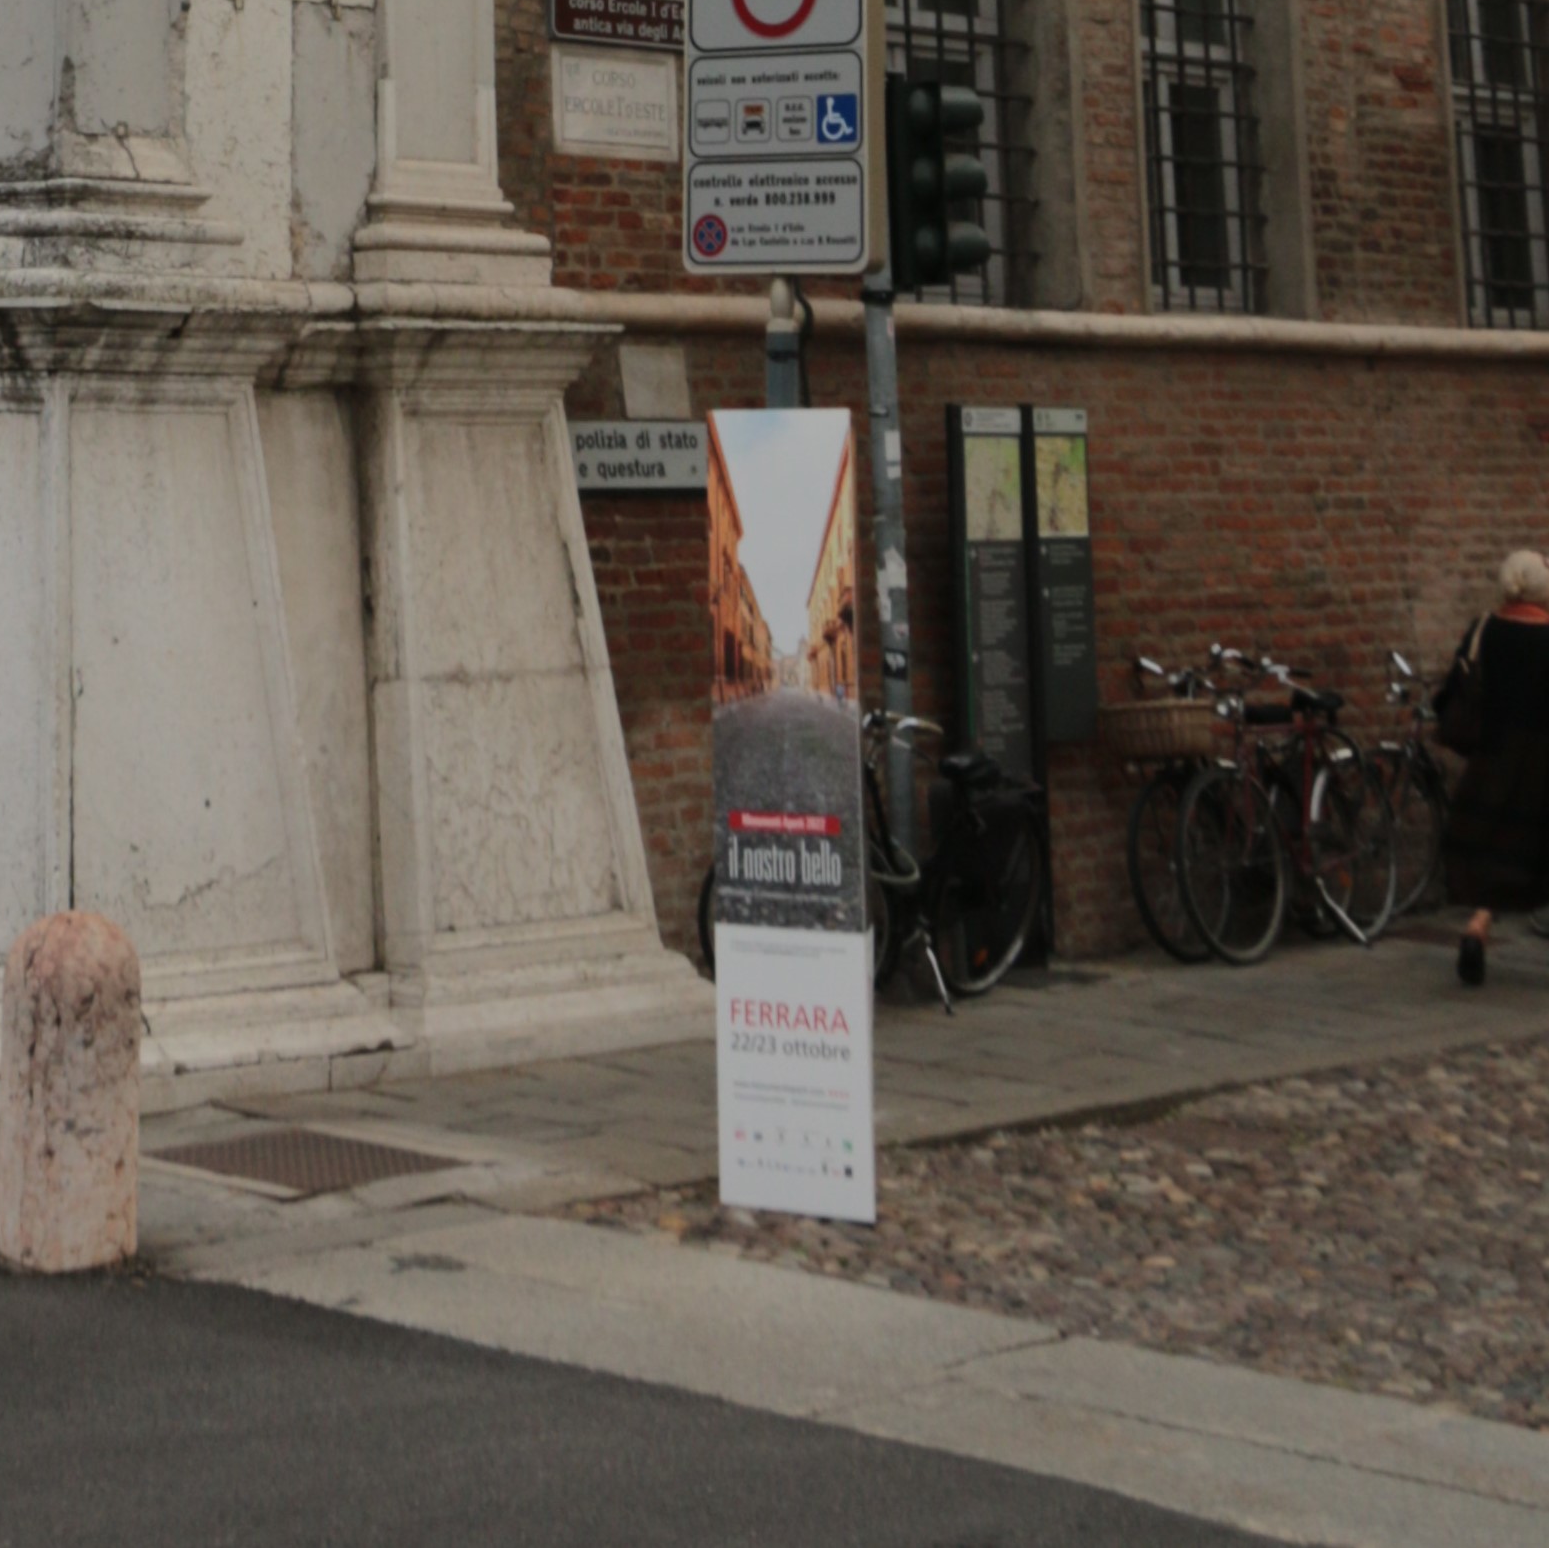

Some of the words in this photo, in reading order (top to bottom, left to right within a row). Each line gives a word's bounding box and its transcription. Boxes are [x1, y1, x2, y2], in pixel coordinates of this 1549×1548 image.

[573, 16, 612, 35] antica
[616, 19, 634, 37] via
[638, 22, 668, 42] degli
[592, 69, 636, 90] CORSO
[564, 95, 614, 117] ERCOLE
[693, 174, 742, 189] controllo
[748, 172, 810, 188] elettronico
[815, 174, 858, 186] accesso
[729, 194, 759, 207] verde
[575, 429, 627, 452] polizia
[635, 430, 650, 450] di
[659, 430, 698, 450] stato
[578, 463, 588, 478] e
[597, 459, 666, 482] questura
[728, 834, 739, 880] il
[743, 843, 796, 884] nostro
[801, 837, 842, 887] bello
[730, 998, 850, 1035] FERRARA
[731, 1031, 777, 1053] 22/23
[783, 1037, 851, 1061] ottobre
